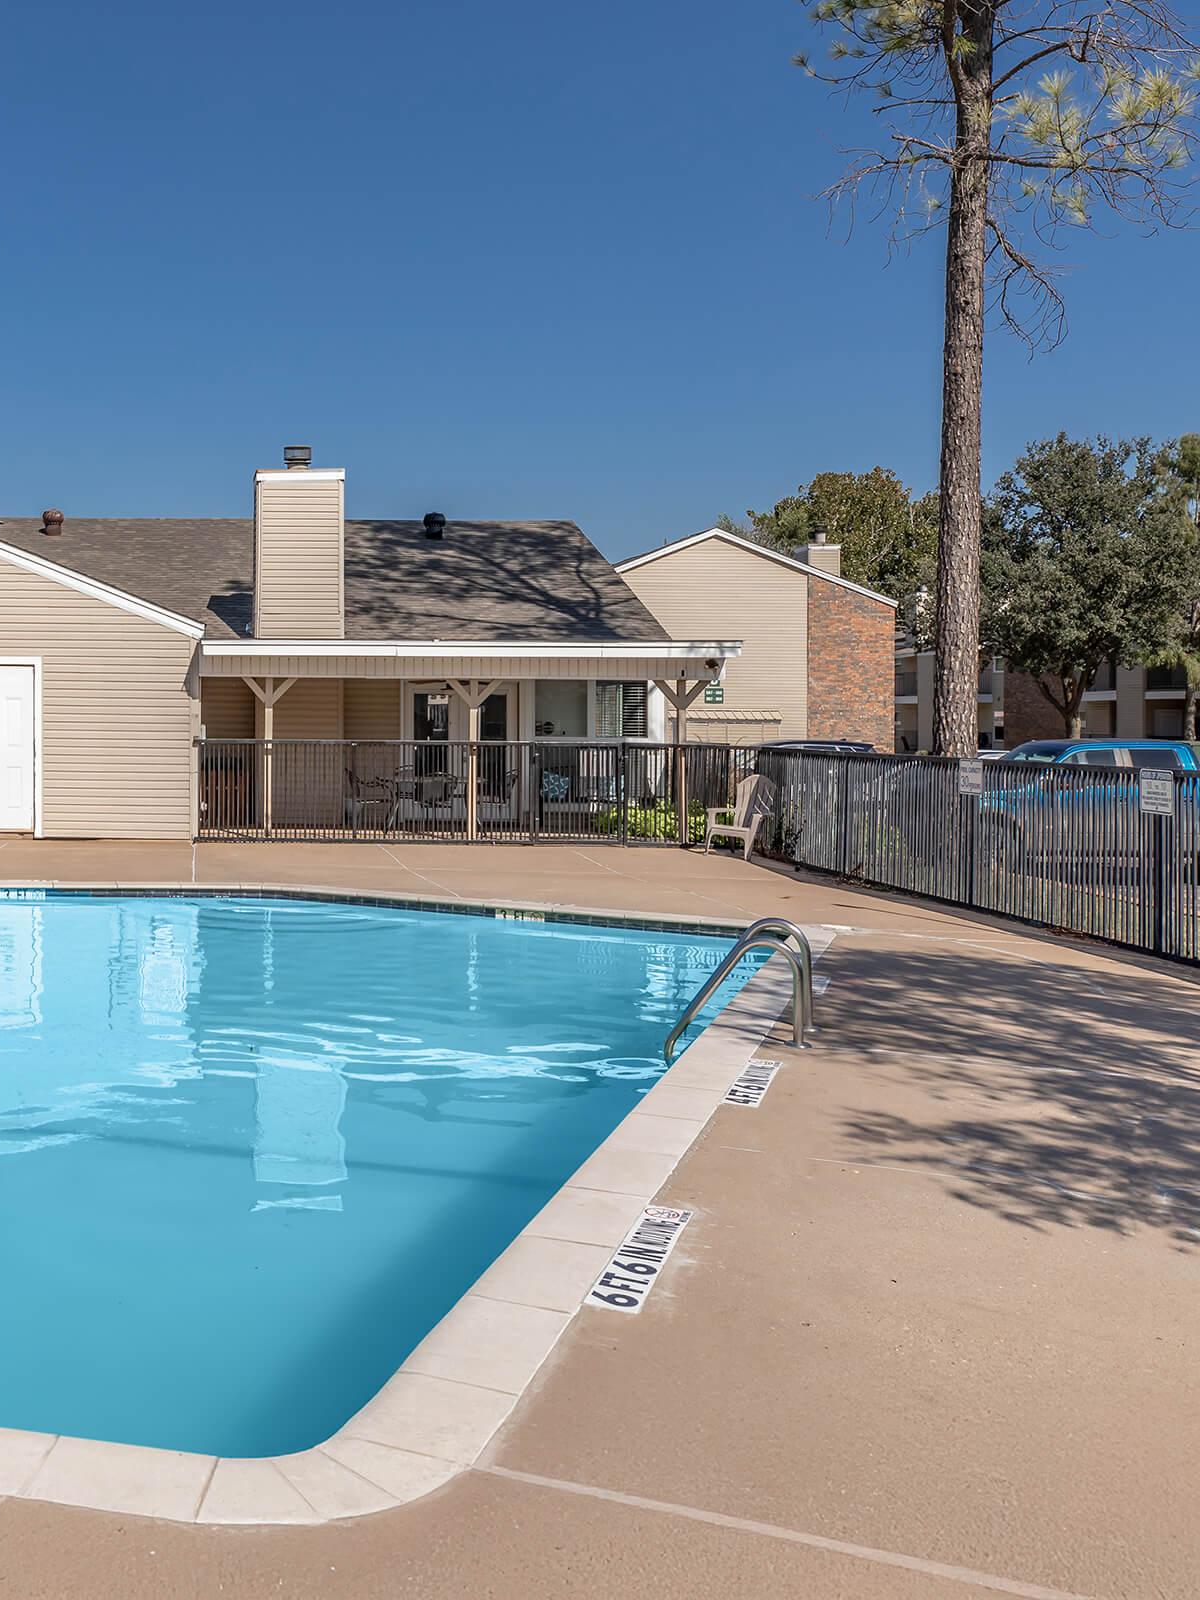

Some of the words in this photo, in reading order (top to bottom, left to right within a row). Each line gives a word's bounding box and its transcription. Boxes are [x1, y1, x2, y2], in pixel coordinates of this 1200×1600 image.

[734, 1083, 765, 1091] 6
[612, 1260, 658, 1275] 6
[591, 1290, 639, 1307] 6
